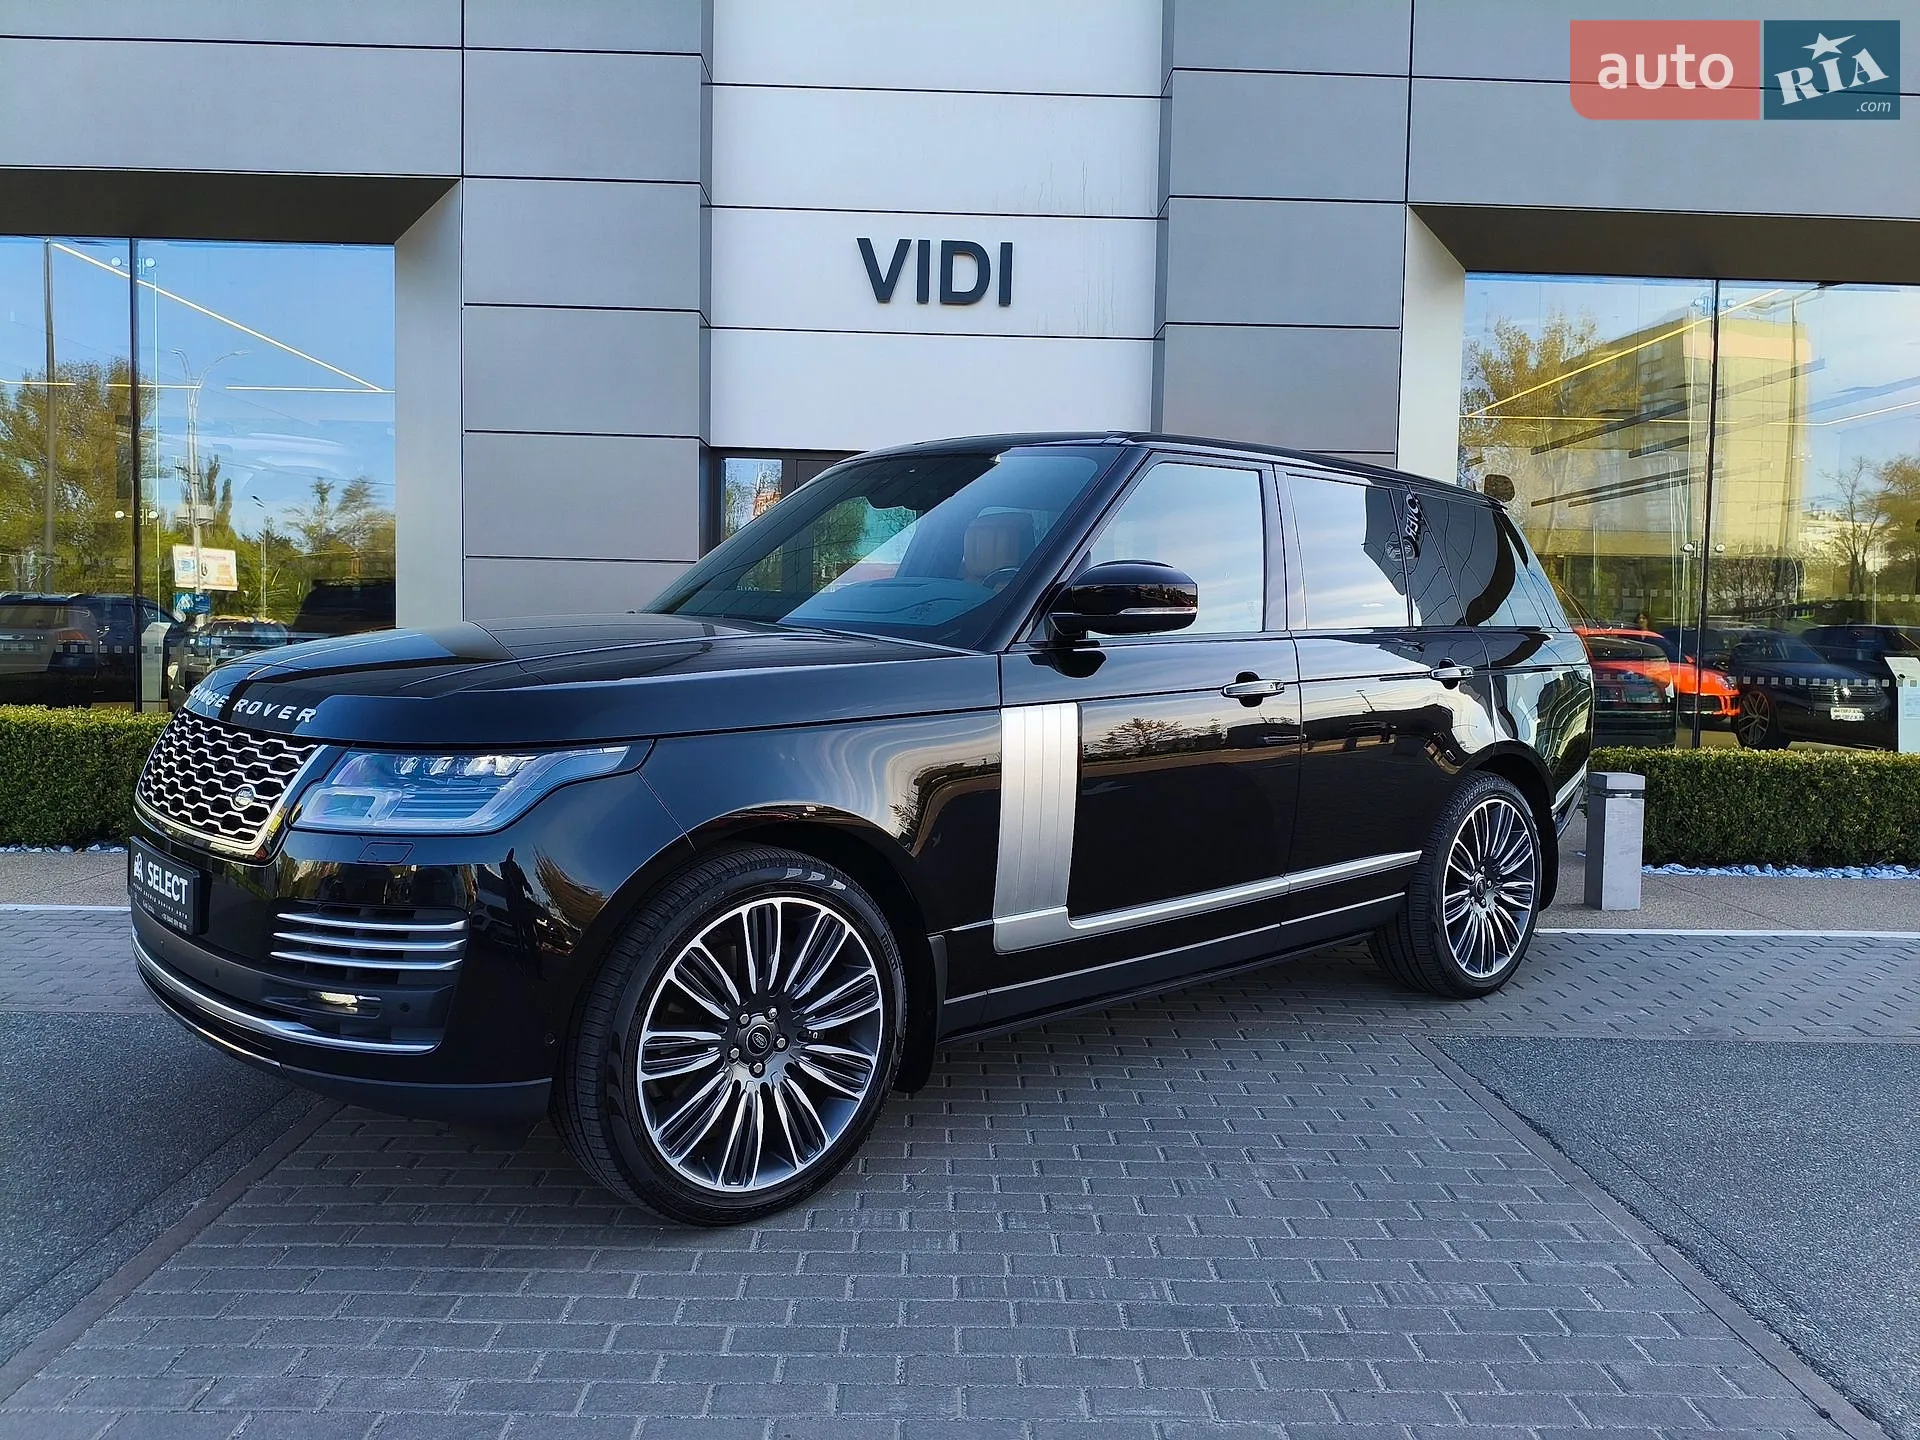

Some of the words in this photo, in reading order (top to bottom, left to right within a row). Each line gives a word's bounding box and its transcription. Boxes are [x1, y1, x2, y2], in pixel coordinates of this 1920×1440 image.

[856, 237, 1014, 307] VIDI
[232, 698, 317, 723] ROVER
[147, 861, 188, 905] SELECT
